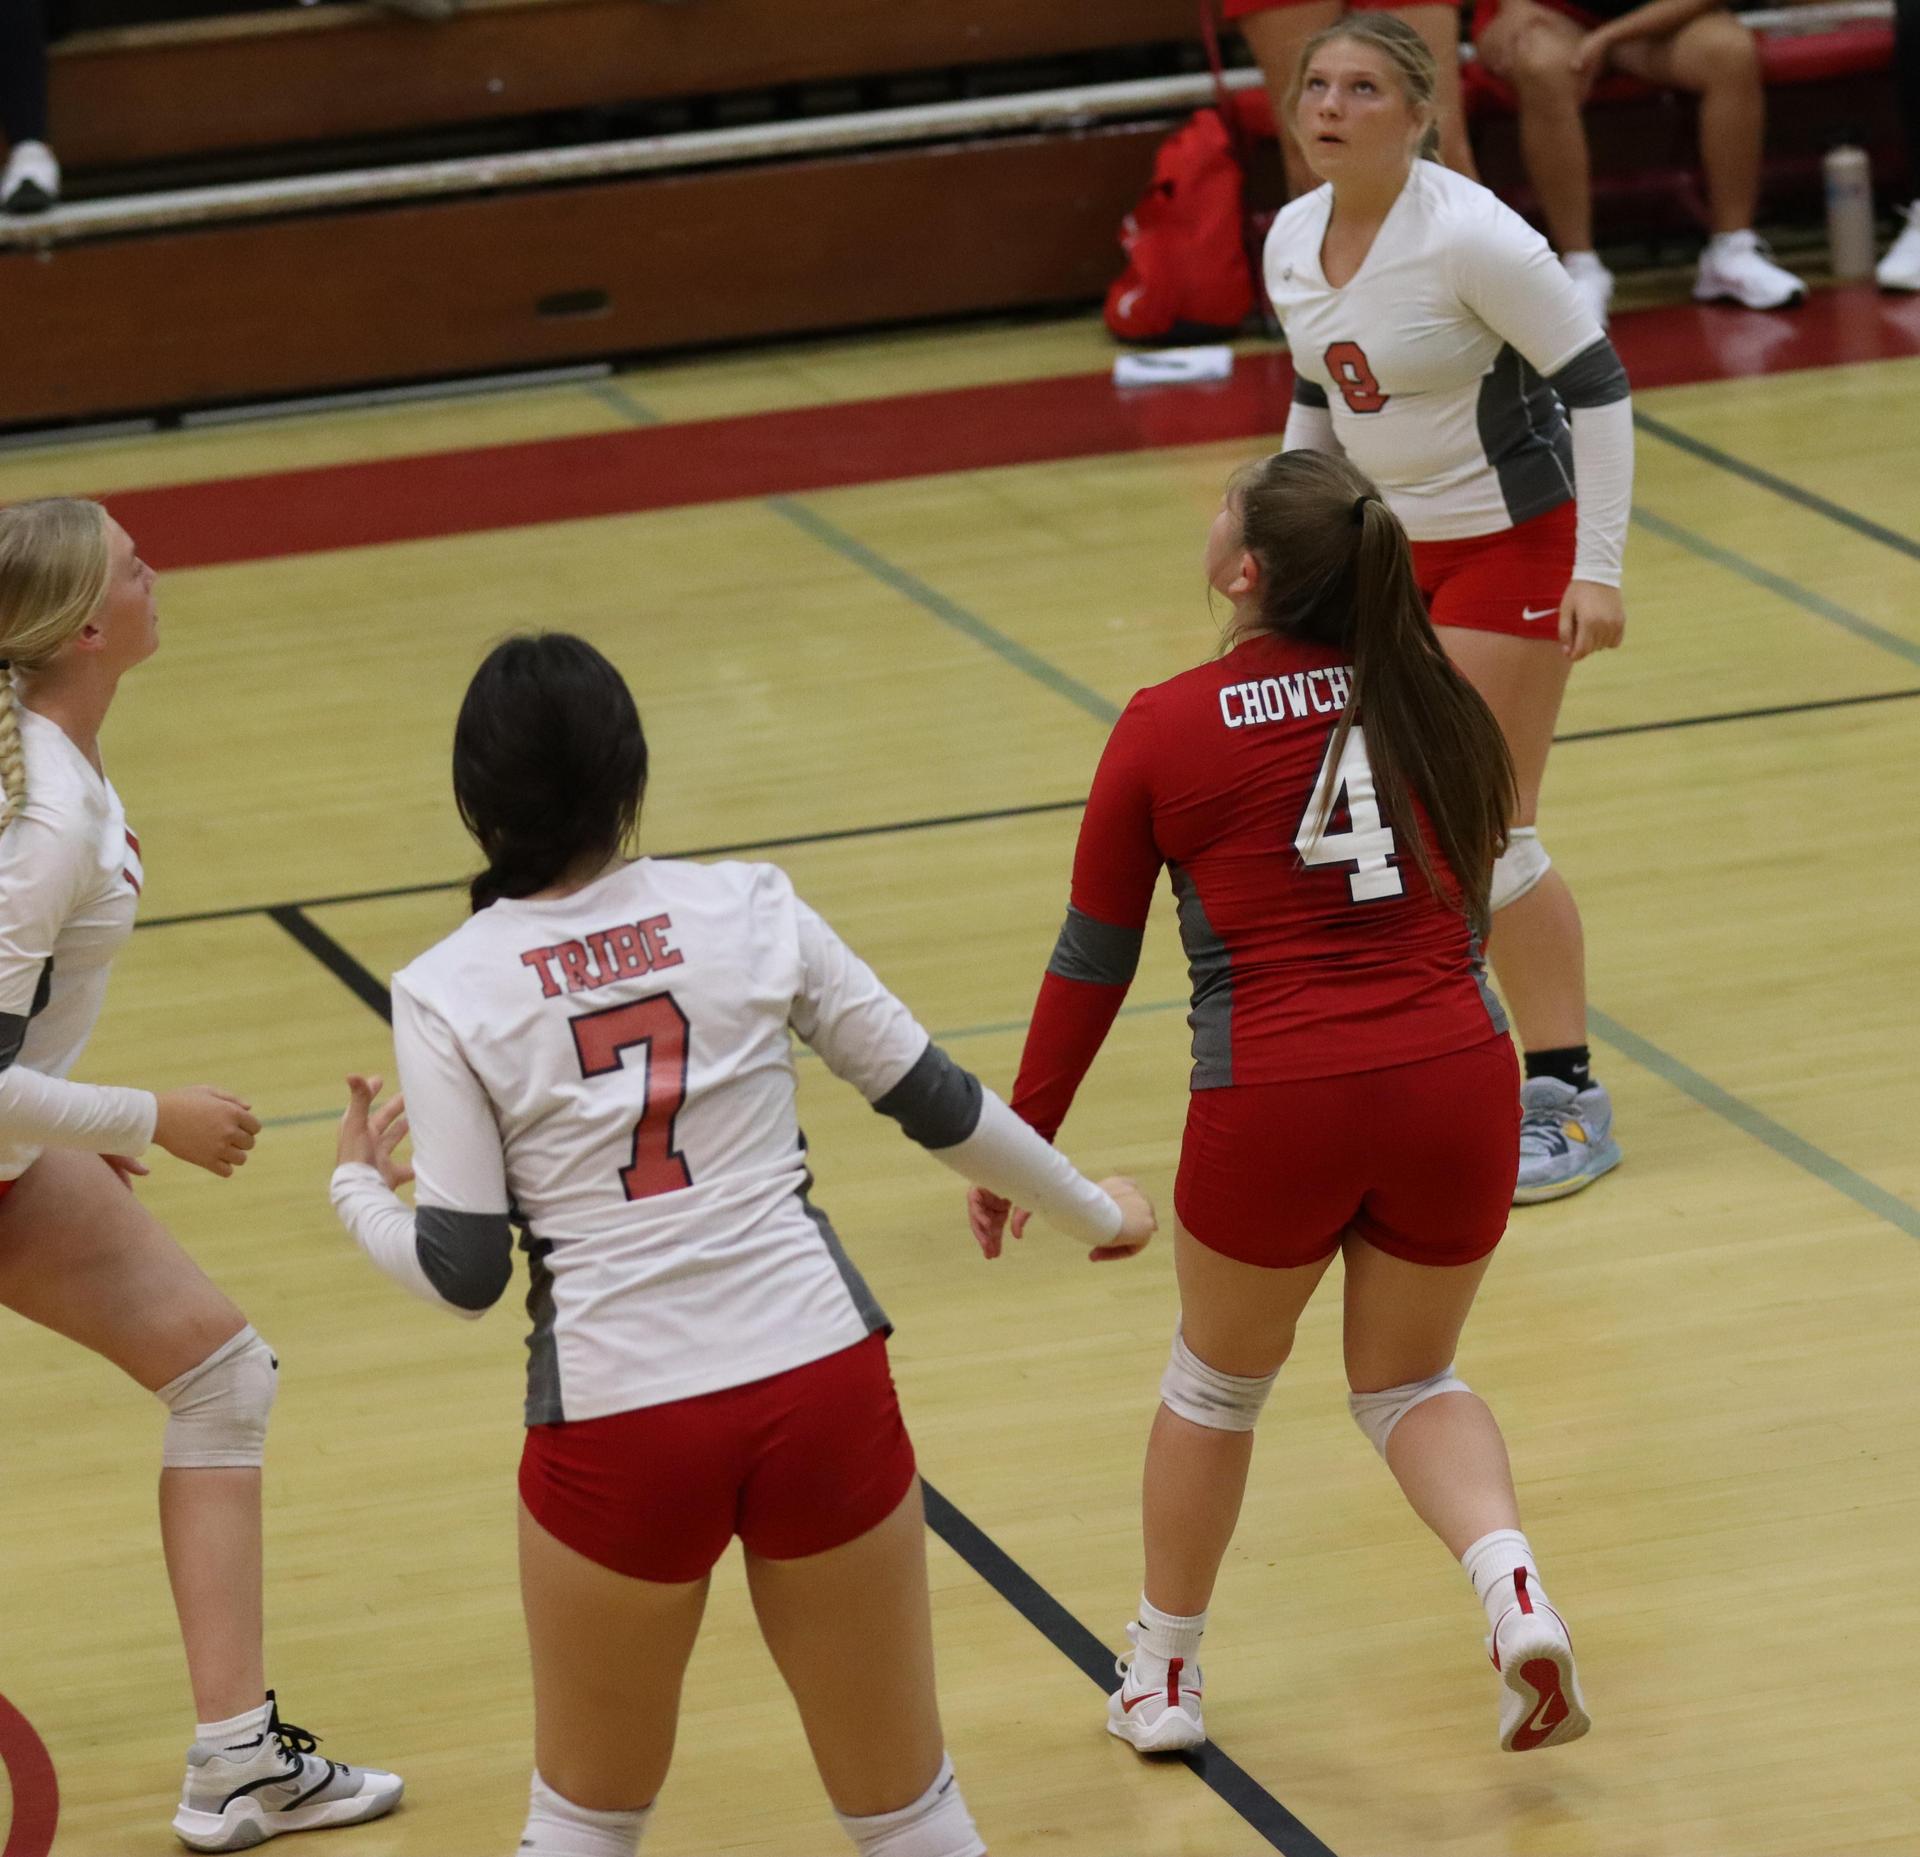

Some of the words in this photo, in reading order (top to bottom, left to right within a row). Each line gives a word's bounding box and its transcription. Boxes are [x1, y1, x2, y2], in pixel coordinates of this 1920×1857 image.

[1218, 665, 1354, 728] CHOWCH
[1294, 725, 1404, 902] 4
[520, 913, 684, 998] TRIBE
[568, 990, 693, 1201] 7
